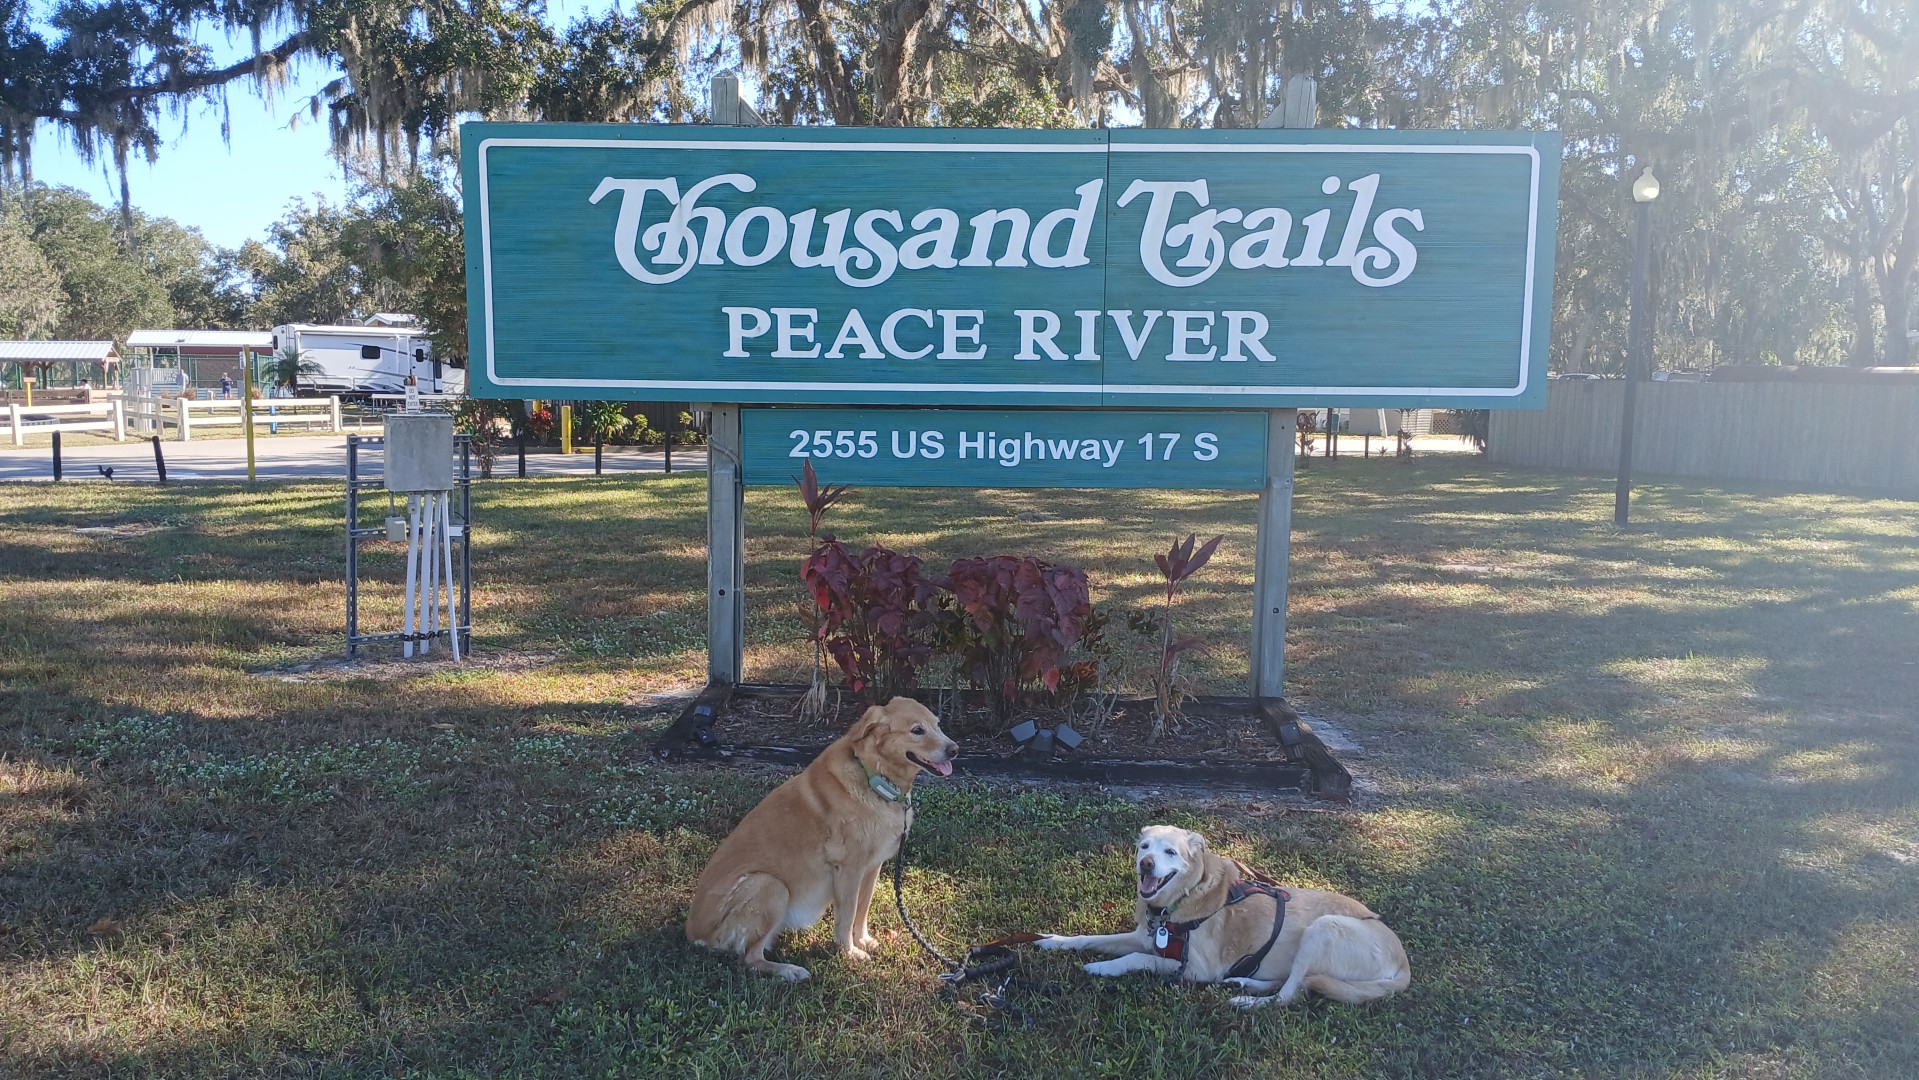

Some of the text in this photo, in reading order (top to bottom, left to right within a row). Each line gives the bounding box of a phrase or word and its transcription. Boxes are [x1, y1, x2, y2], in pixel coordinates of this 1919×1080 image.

[588, 173, 1425, 288] Thousand Trails
[721, 306, 1277, 362] PEACE RIVER
[788, 429, 1219, 468] 2555 US Highway 17 S
